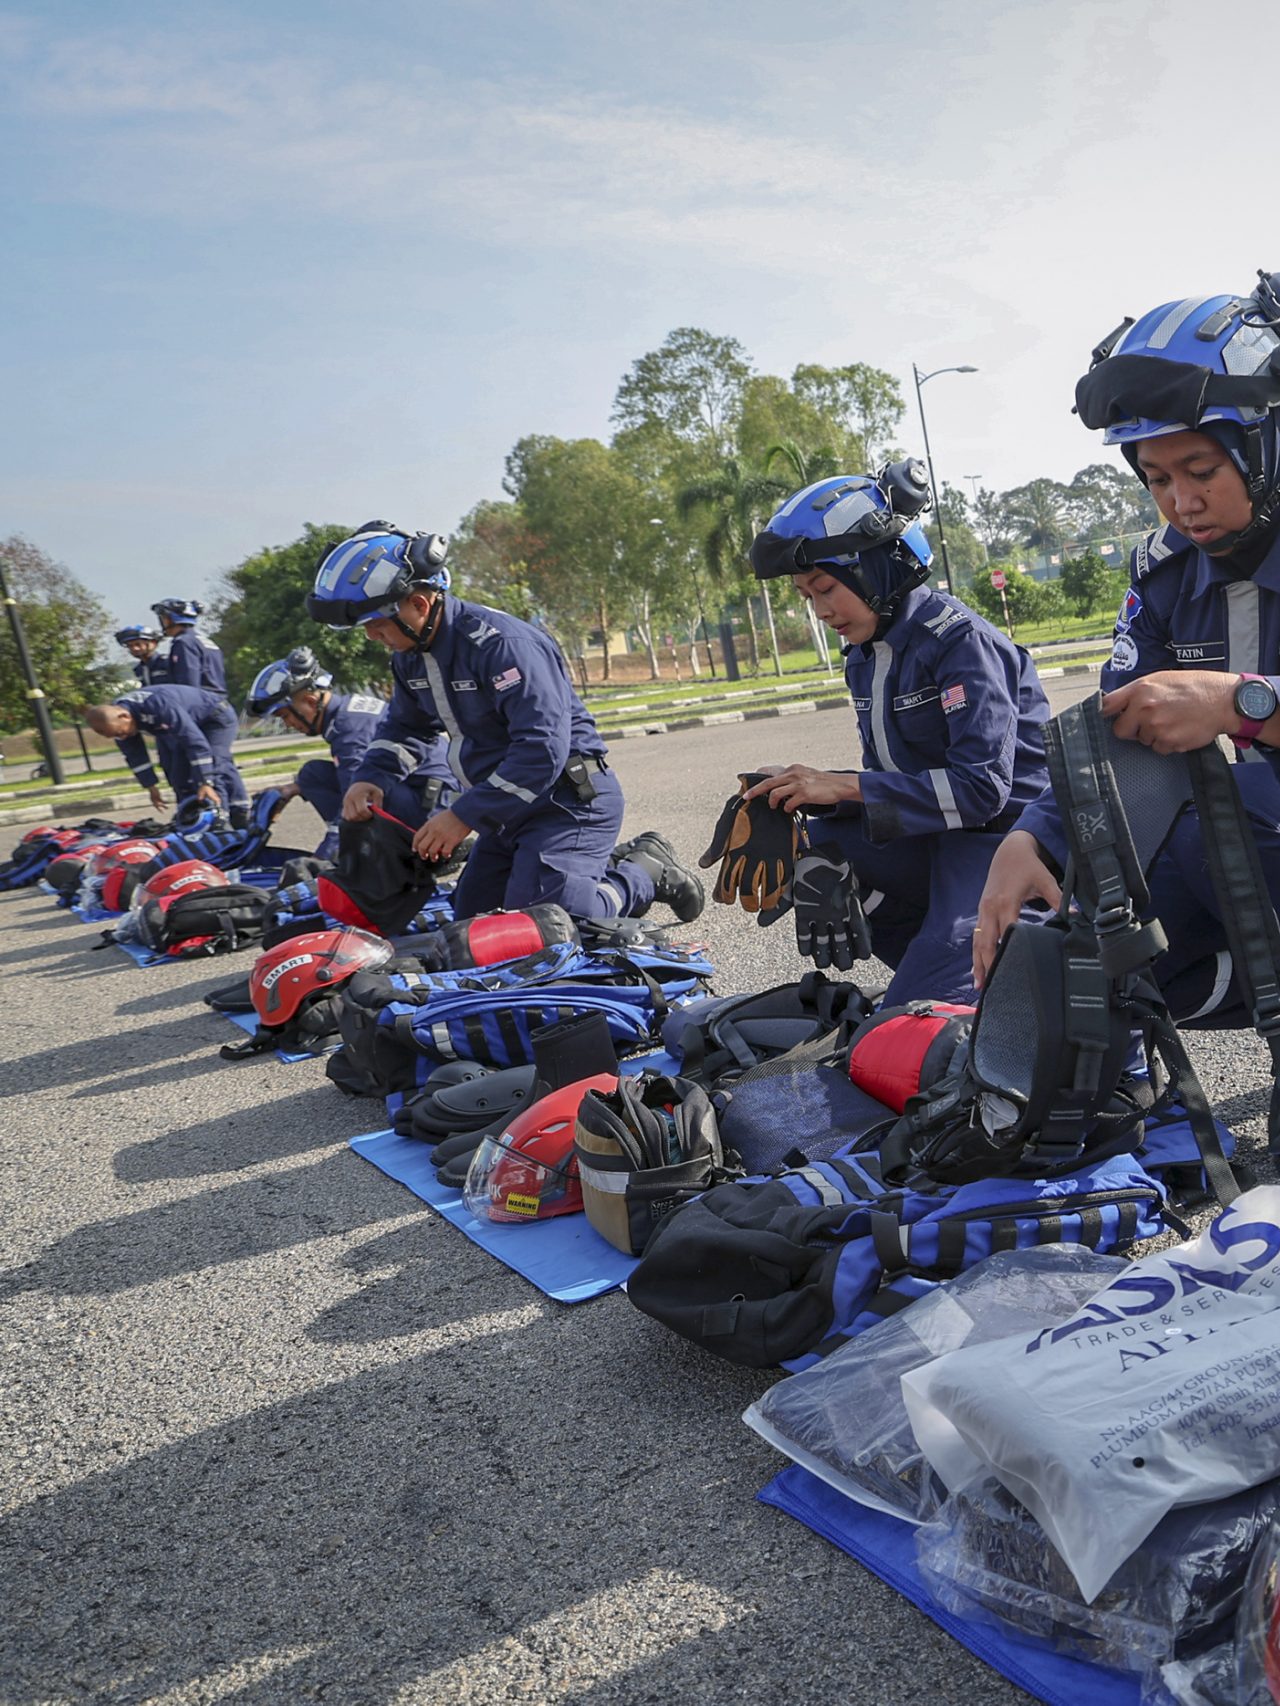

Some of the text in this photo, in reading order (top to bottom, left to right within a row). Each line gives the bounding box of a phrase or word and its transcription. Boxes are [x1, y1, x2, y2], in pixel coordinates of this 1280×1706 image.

[1177, 648, 1204, 658] FATIN
[1077, 812, 1092, 842] CMC
[265, 956, 306, 986] SMART
[508, 1200, 537, 1210] WARNING
[1070, 1321, 1153, 1350] TRADE
[1160, 1313, 1175, 1325] &
[1098, 1425, 1126, 1442] No
[1128, 1388, 1184, 1426] AAG/44
[1176, 1403, 1217, 1431] 40000
[1216, 1385, 1251, 1411] Shah
[1090, 1407, 1177, 1470] PLUMBUM
[1179, 1377, 1237, 1411] AA7/AA
[1178, 1433, 1207, 1454] Tel:
